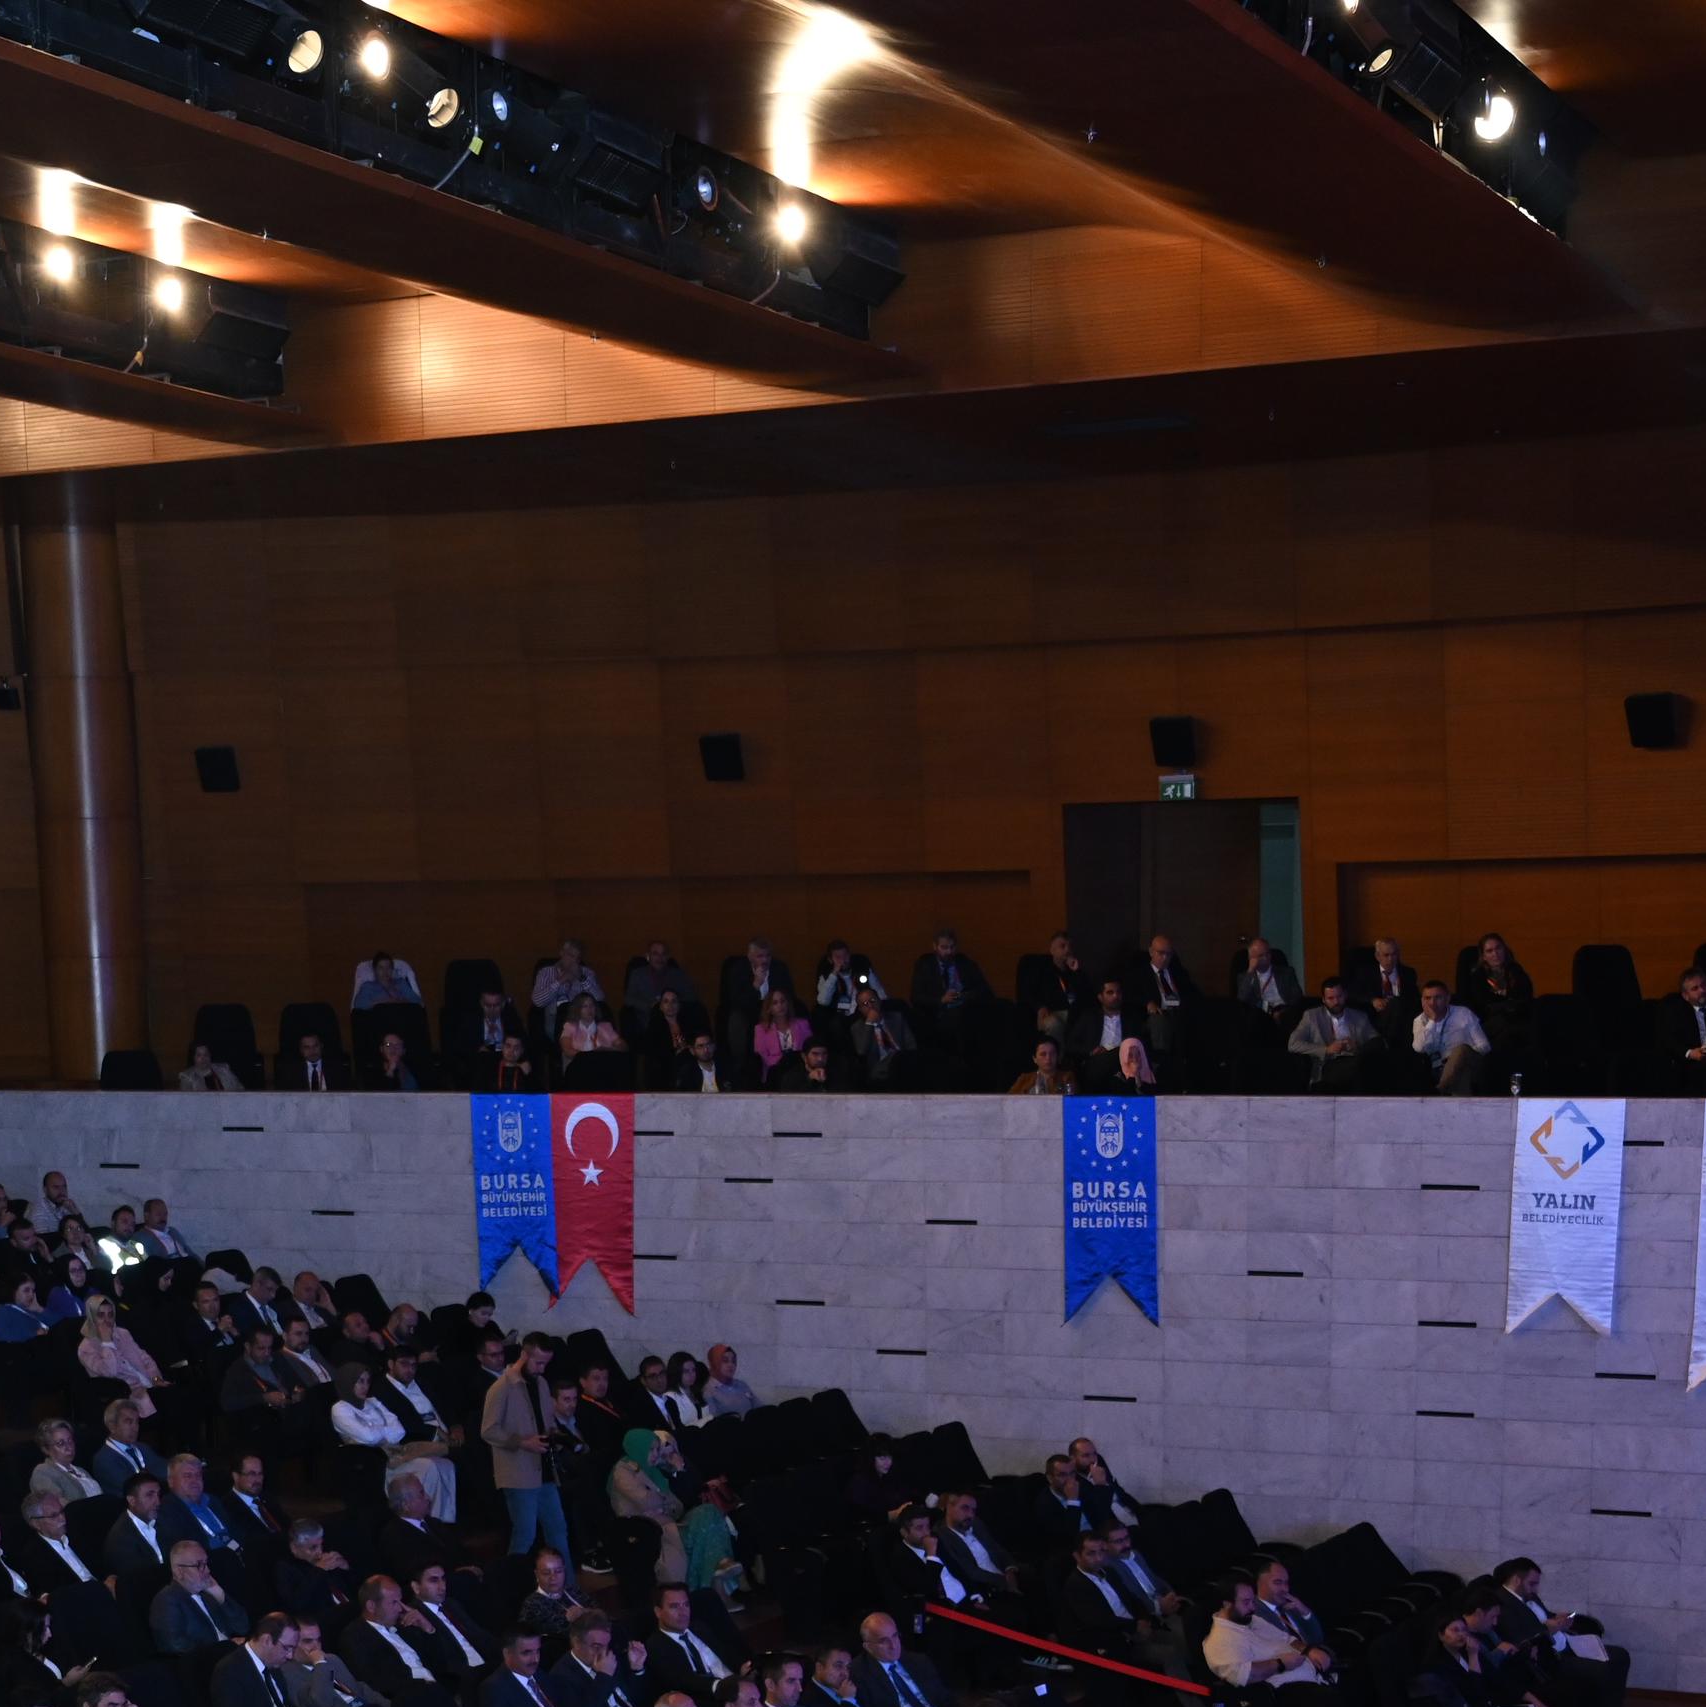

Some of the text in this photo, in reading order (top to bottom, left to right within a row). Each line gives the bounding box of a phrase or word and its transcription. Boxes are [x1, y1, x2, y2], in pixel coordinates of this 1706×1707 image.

[480, 1173, 546, 1191] BURSA
[1072, 1181, 1148, 1199] BURSA
[1072, 1199, 1148, 1214] BÜYÜKŞEHİR
[1532, 1192, 1597, 1211] YALIN
[482, 1203, 548, 1218] BELEDİYESİ
[1072, 1215, 1148, 1229] BELEDİYESİ
[1521, 1212, 1605, 1226] BELEDİYECİLİK
